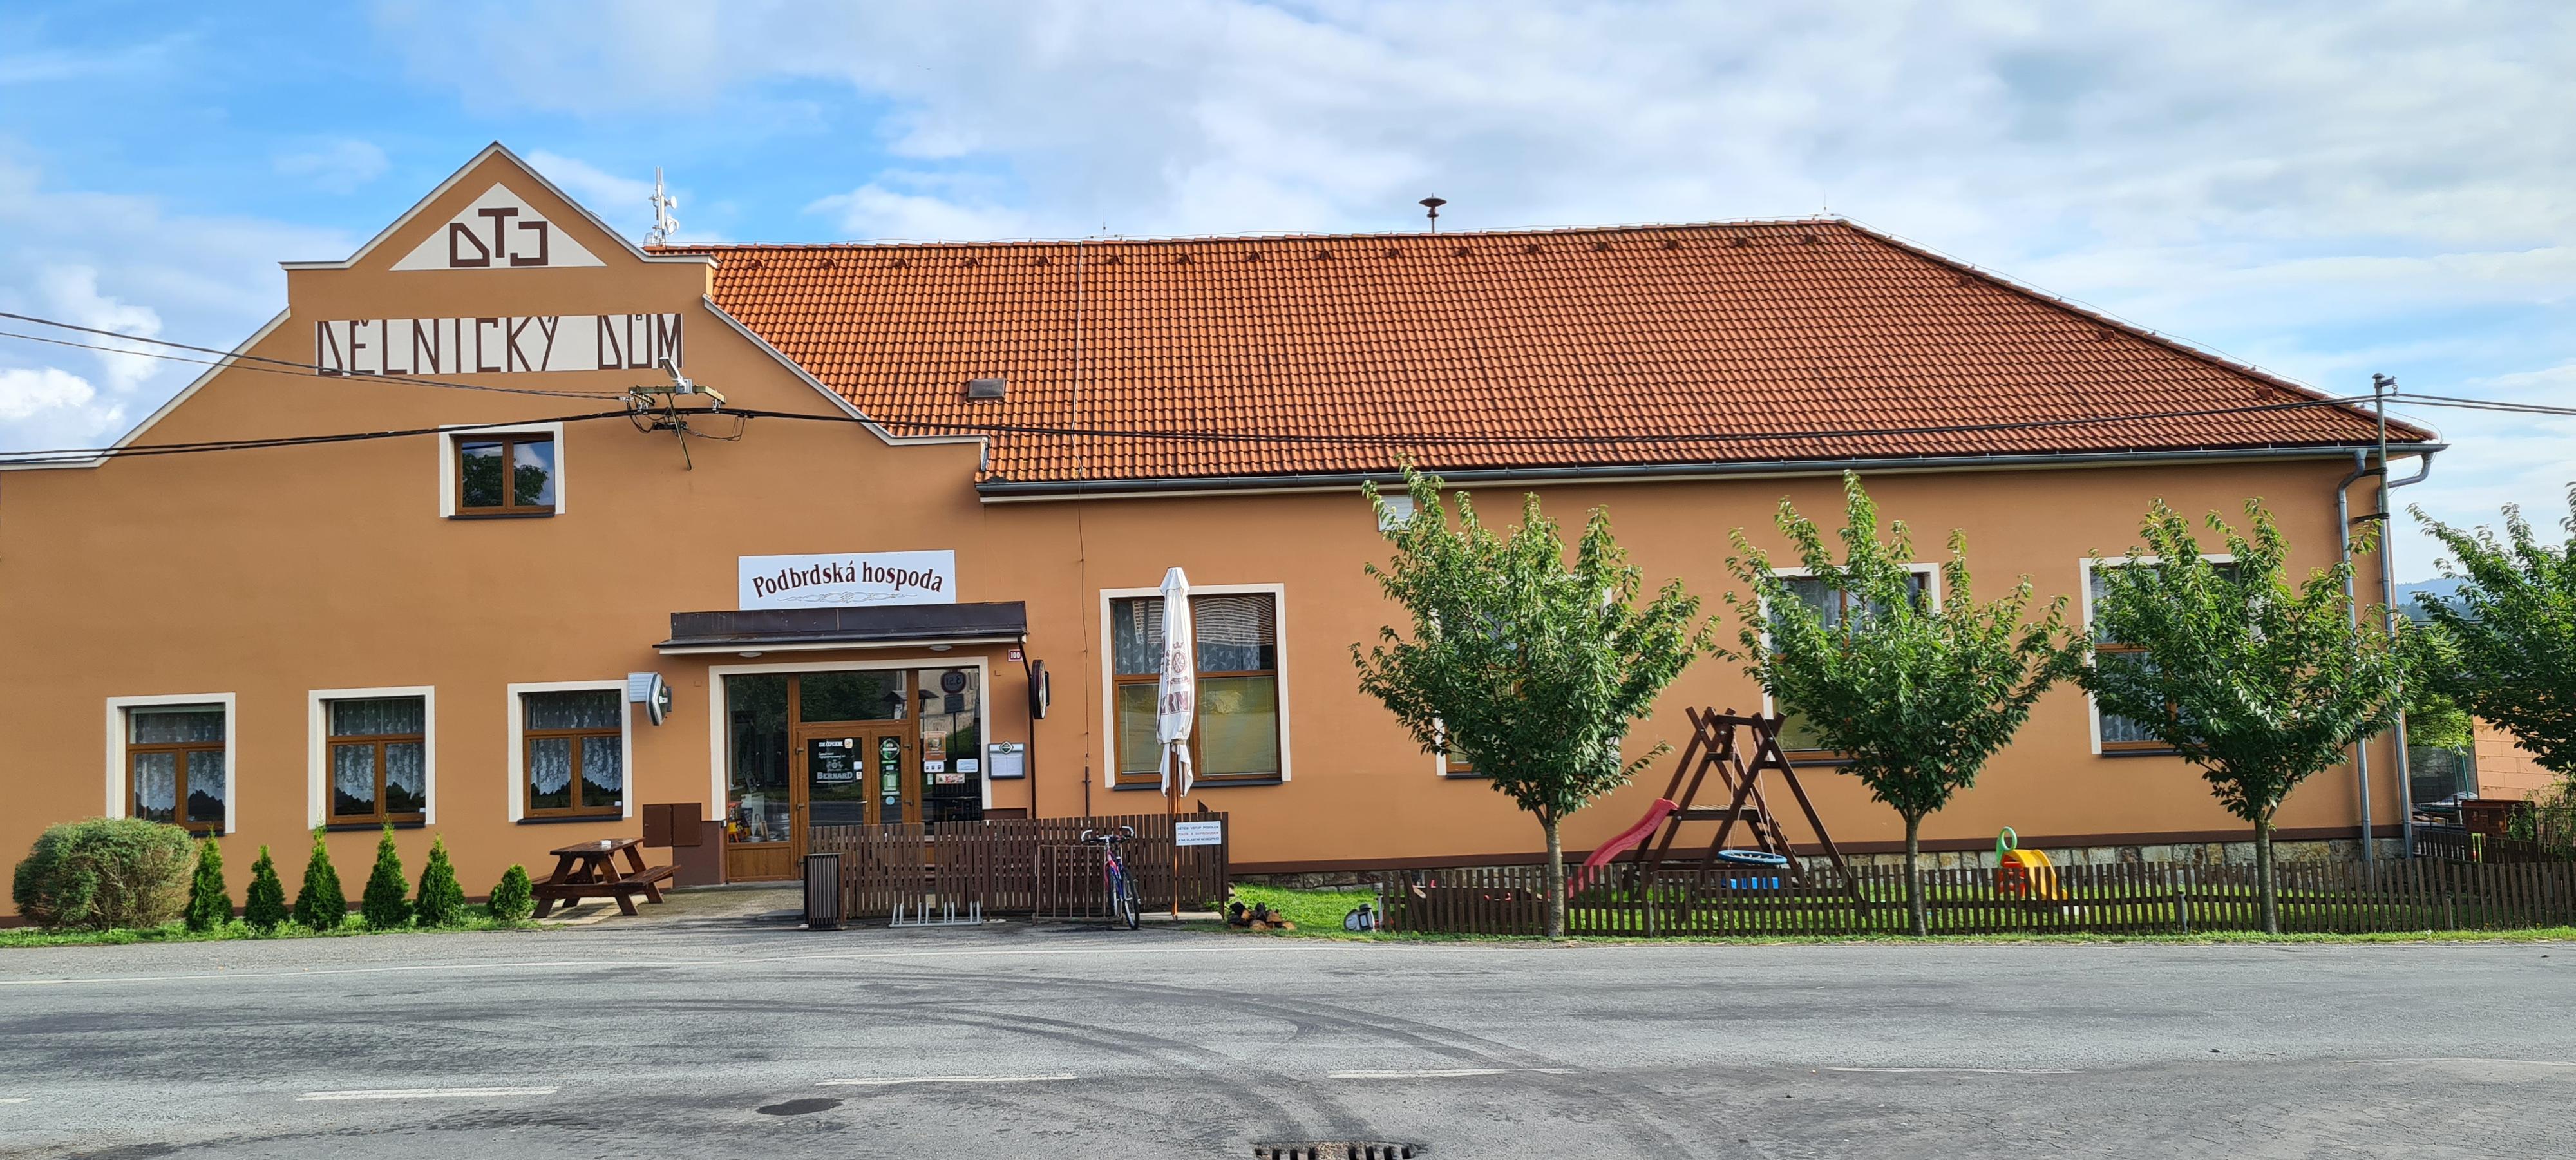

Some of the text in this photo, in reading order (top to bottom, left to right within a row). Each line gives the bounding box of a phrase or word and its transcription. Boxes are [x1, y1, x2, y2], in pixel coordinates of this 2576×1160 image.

[450, 207, 548, 267] DTJ
[317, 314, 682, 375] DĚLNICKÝ DŮM
[752, 560, 943, 598] Podbrdská hospoda
